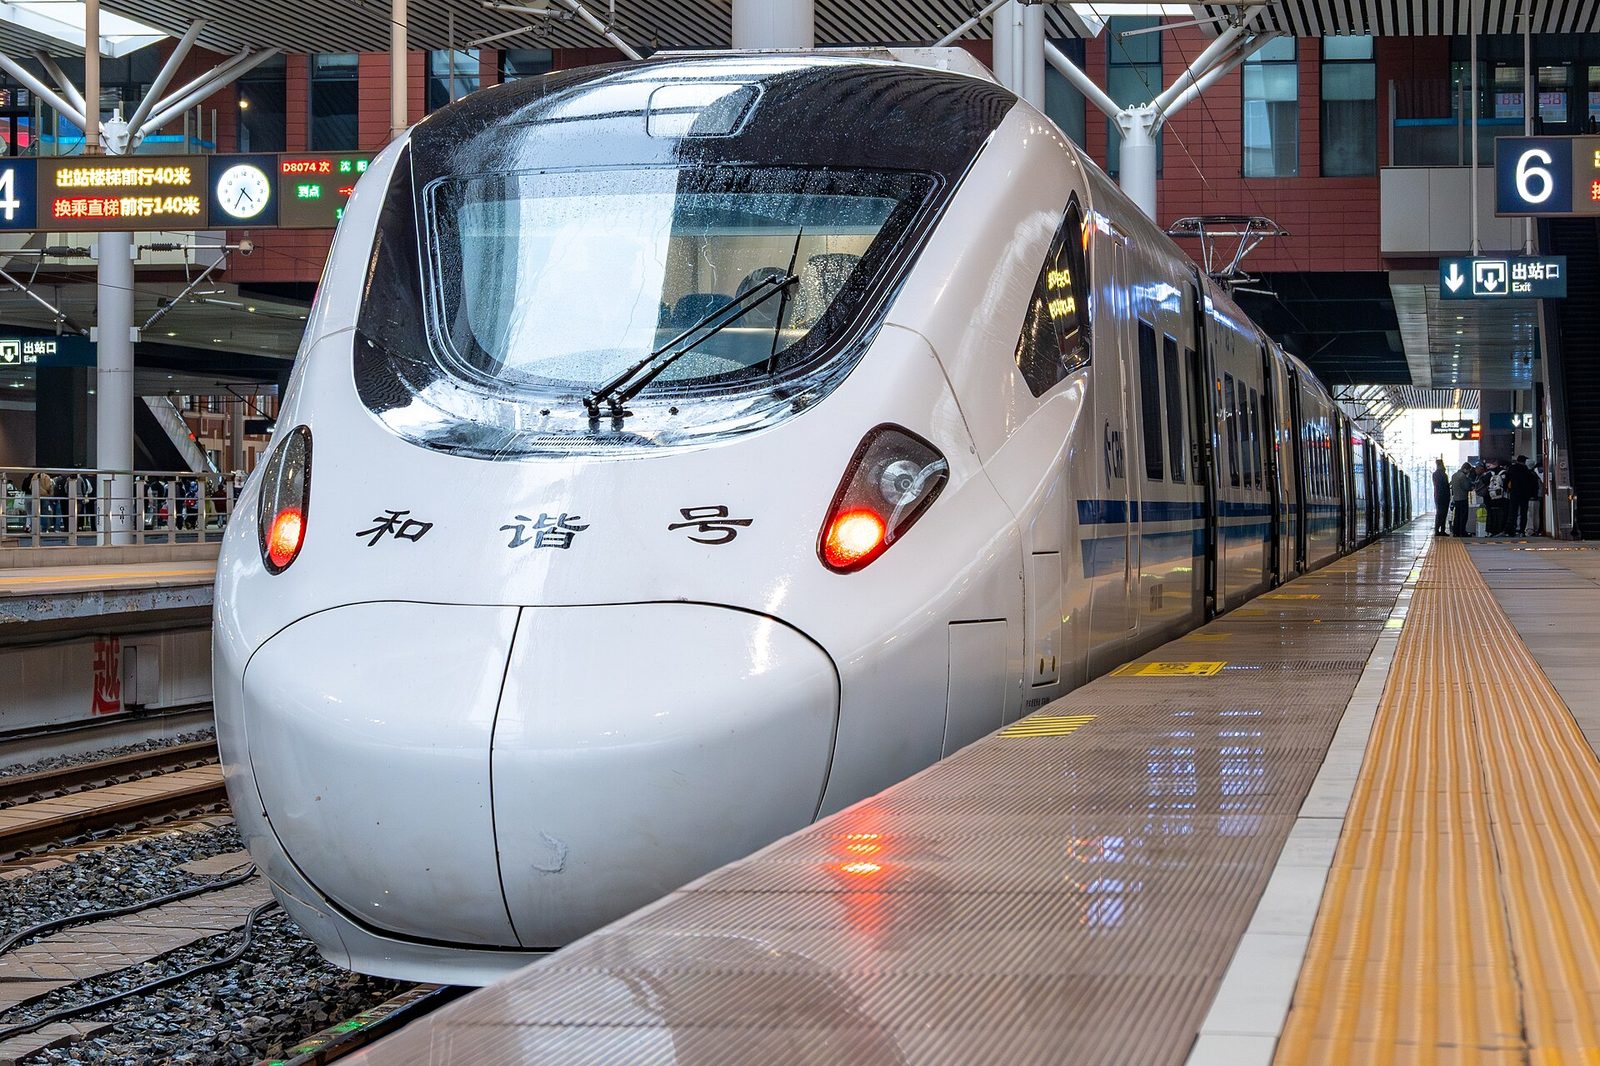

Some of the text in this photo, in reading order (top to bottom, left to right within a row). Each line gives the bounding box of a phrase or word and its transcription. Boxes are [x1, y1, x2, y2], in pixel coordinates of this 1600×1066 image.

[283, 161, 330, 173] D8074 次
[1516, 149, 1553, 204] 6
[56, 167, 191, 187] 出站楼梯前行40米
[55, 196, 200, 217] 换乘直梯前行140米
[1512, 262, 1560, 281] 出站口
[1512, 281, 1532, 292] Exit
[24, 341, 56, 354] 出站口
[355, 505, 754, 548] 和谐号
